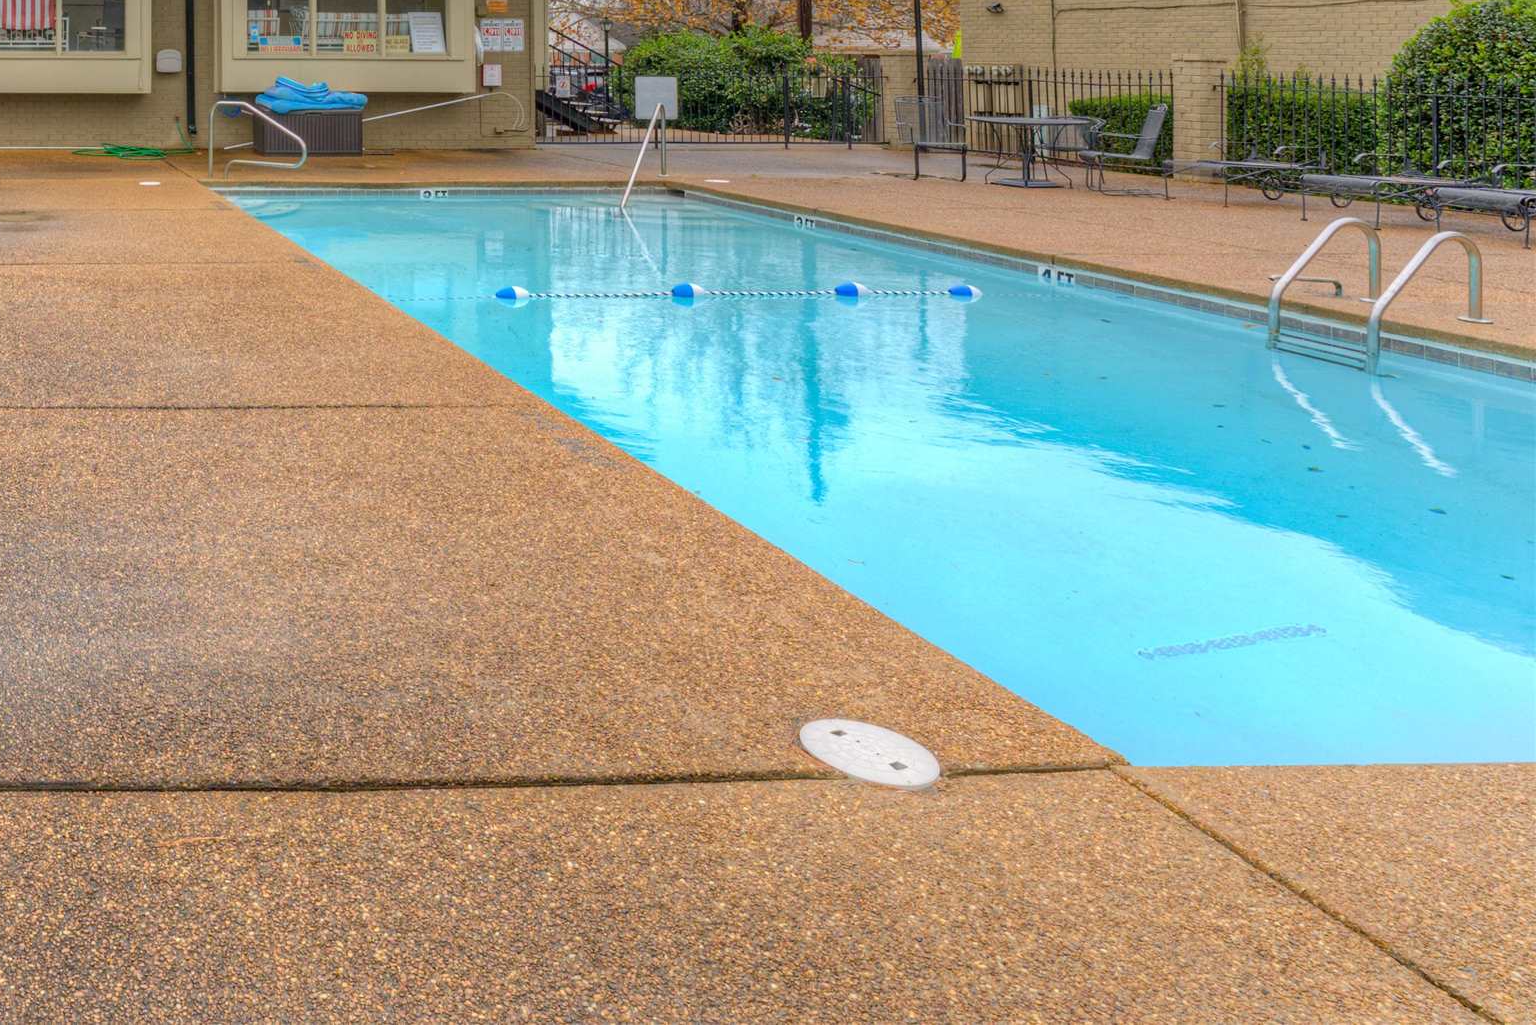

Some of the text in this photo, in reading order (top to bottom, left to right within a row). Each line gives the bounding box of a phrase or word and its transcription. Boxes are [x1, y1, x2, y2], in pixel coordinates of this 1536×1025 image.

[344, 31, 378, 39] NO DIVING
[346, 44, 375, 52] ALLOWED
